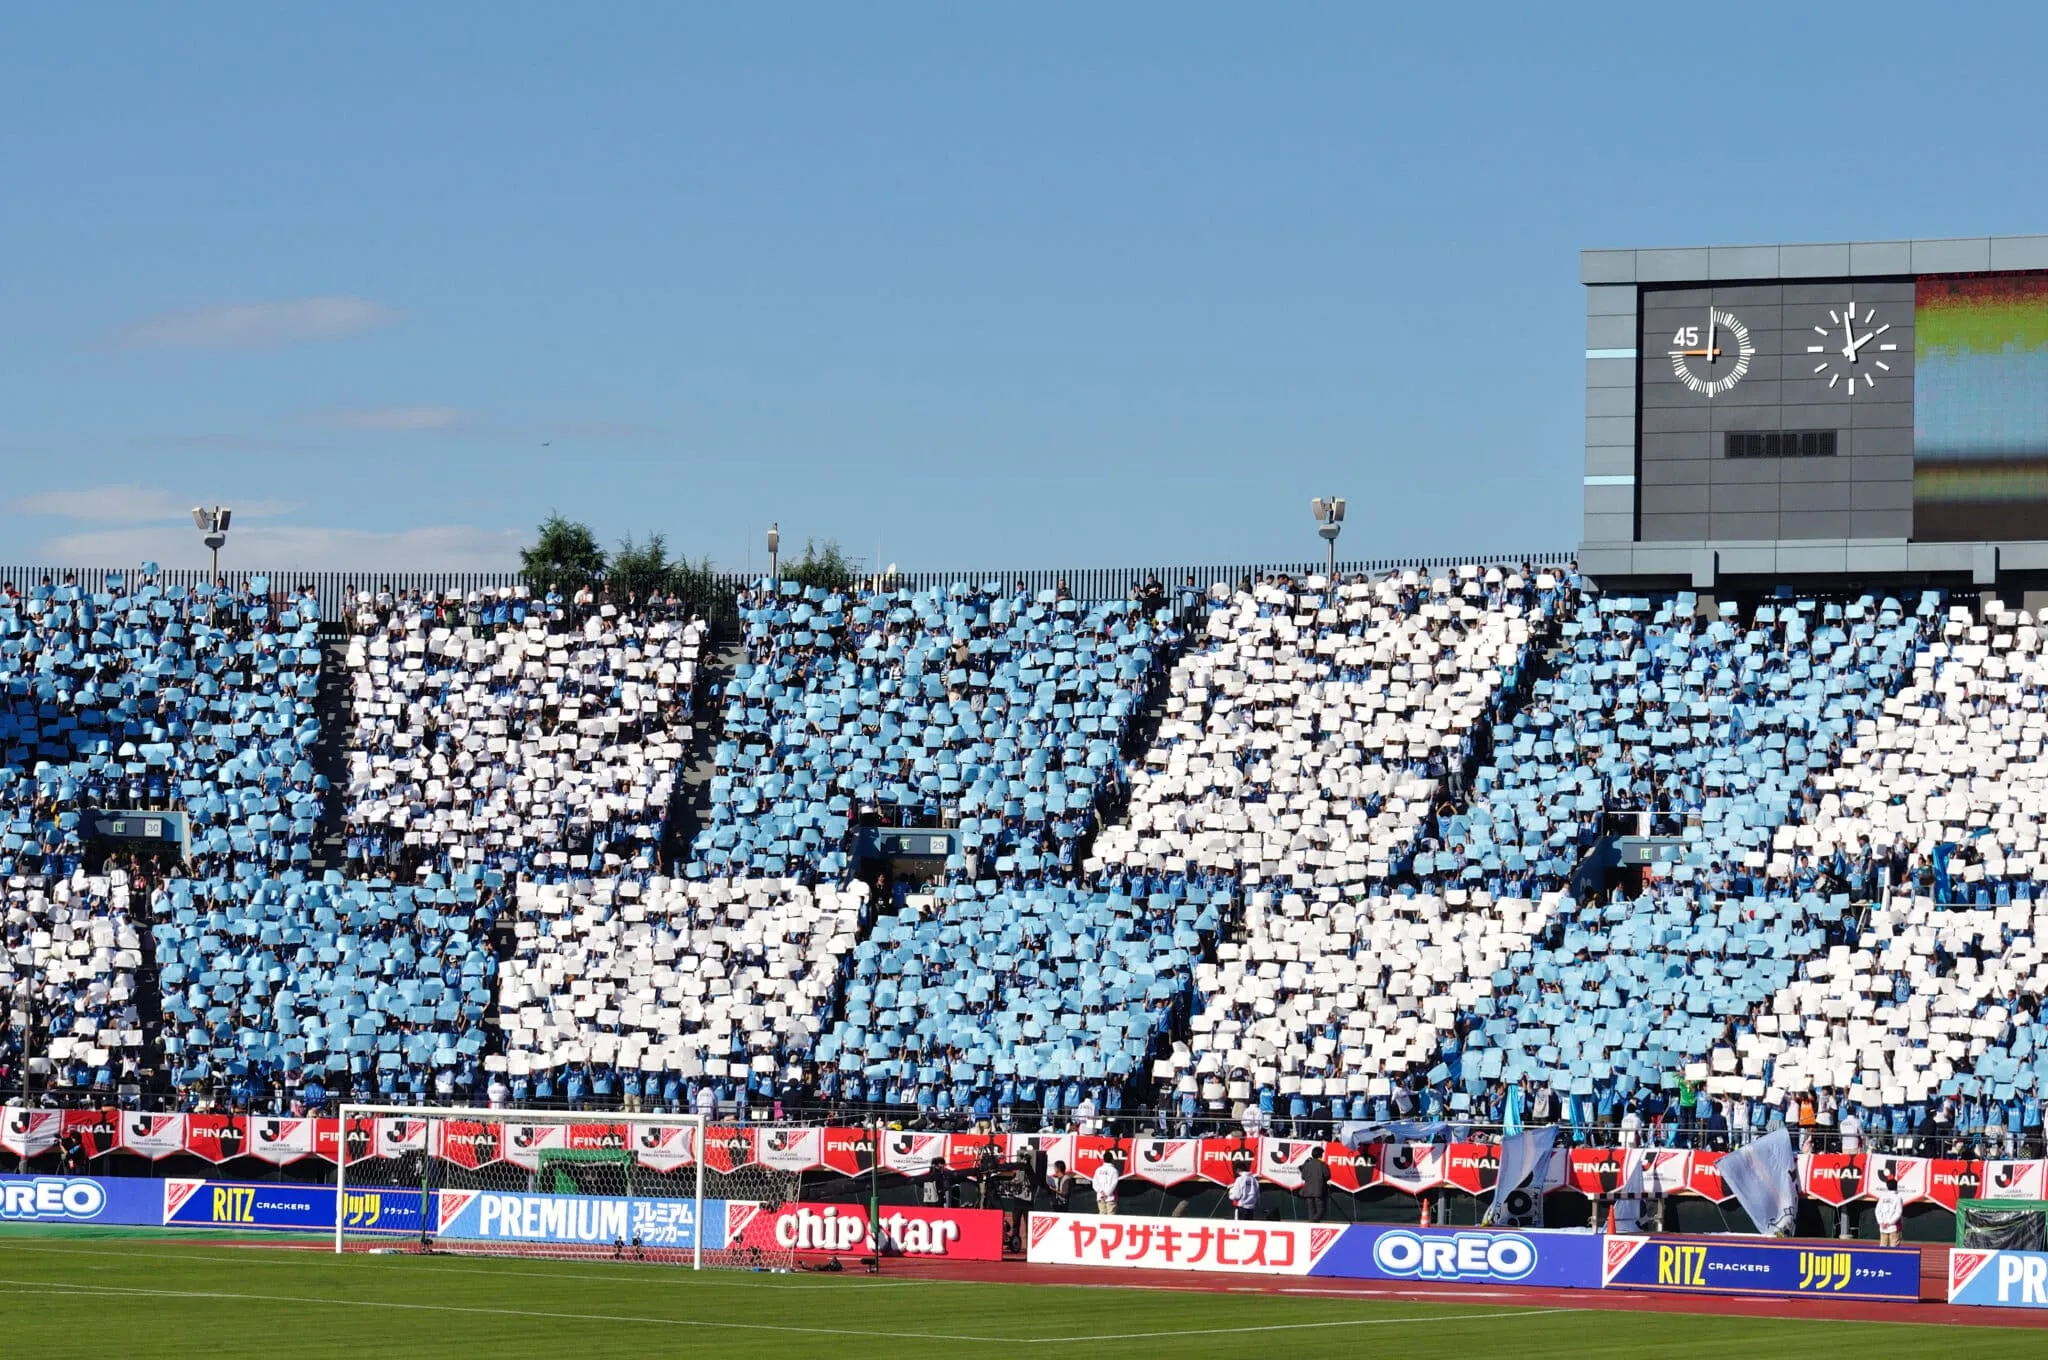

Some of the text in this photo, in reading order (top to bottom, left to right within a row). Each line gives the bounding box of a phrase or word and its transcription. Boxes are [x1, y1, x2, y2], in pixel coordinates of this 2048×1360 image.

[1673, 326, 1698, 346] 45
[147, 823, 159, 832] 30
[932, 841, 944, 849] 29
[67, 1124, 115, 1134] FINAL
[192, 1127, 244, 1139] FINAL
[447, 1134, 498, 1146] FINAL
[573, 1137, 624, 1146] FINAL
[827, 1141, 875, 1152] FINAL
[1204, 1150, 1254, 1161] FINAL
[1327, 1155, 1376, 1167] FINAL
[1452, 1157, 1500, 1169] FINAL
[1573, 1161, 1620, 1173] FINAL
[1694, 1163, 1721, 1176] FIN
[1813, 1168, 1862, 1180] FINAL
[1933, 1174, 1980, 1186] FINAL
[0, 1181, 96, 1214] REO
[212, 1187, 255, 1222] RITZ
[256, 1201, 311, 1211] CRACKERS
[383, 1207, 415, 1216] クラッカー
[632, 1201, 694, 1225] プレミアム
[480, 1194, 628, 1243] PREMIUM
[632, 1222, 690, 1243] クラッカー
[1069, 1220, 1295, 1267] ヤマザキナビスコ
[1378, 1234, 1532, 1274] OREO
[1658, 1245, 1707, 1286] RITZ
[1708, 1262, 1770, 1273] CRACKERS
[1799, 1252, 1892, 1290] リッツ クラッカー
